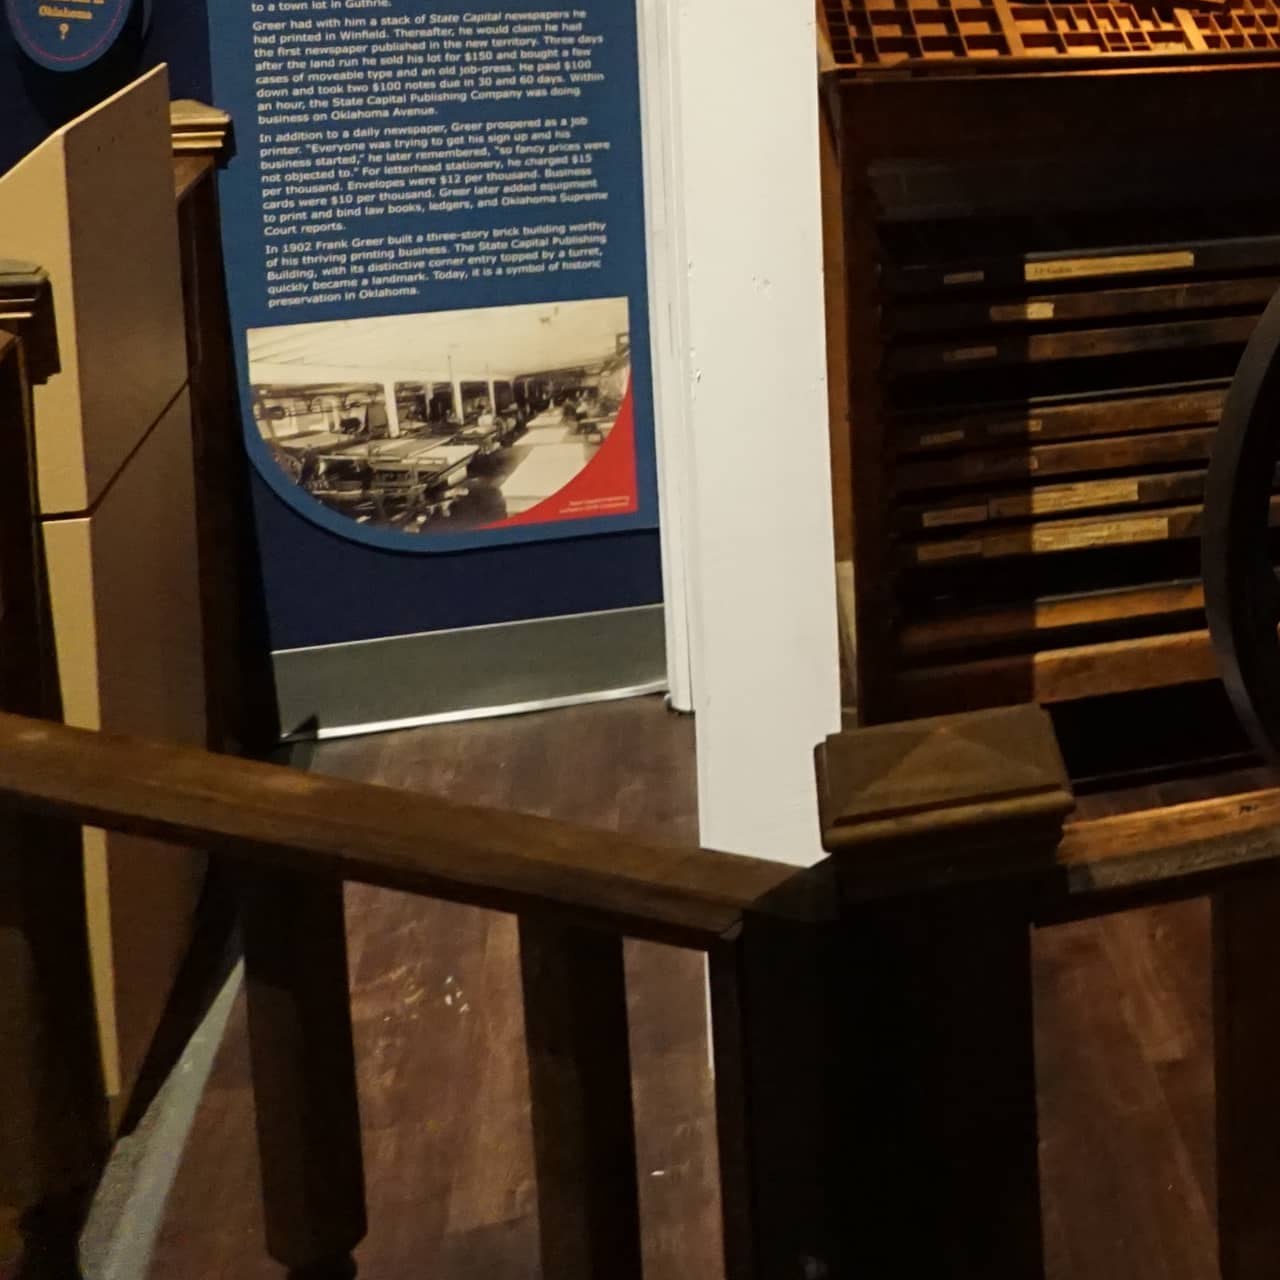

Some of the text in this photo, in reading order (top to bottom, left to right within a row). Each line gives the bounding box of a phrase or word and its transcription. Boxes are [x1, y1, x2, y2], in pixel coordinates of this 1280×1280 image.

[265, 222, 606, 254] In 1902 Frank Greer built a three-story brick building worthy
